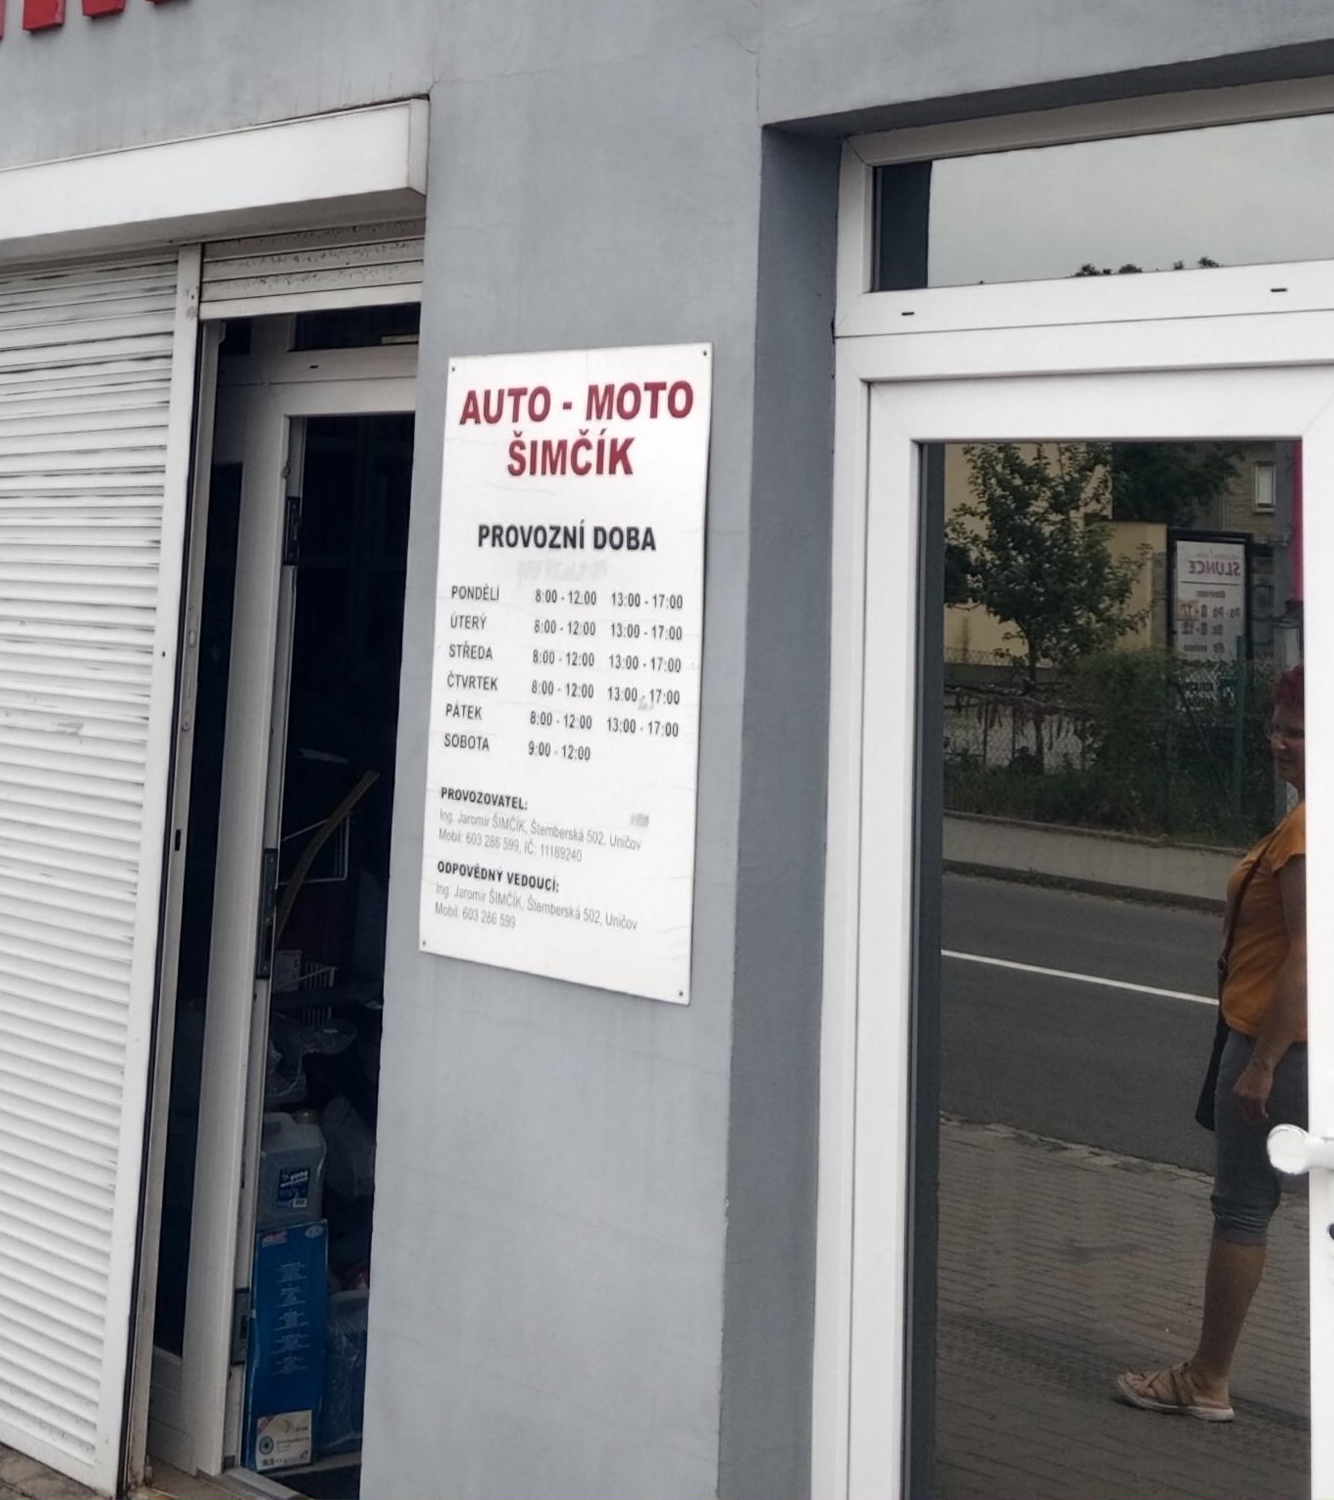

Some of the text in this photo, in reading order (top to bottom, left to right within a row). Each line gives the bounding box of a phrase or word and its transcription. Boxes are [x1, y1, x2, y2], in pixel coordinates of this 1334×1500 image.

[459, 386, 551, 425] AUTO
[586, 380, 694, 421] MOTO
[507, 428, 635, 476] ŠIMČÍK
[478, 519, 656, 551] PROVOZNÍ DOBA
[535, 589, 557, 603] 8:00
[568, 589, 597, 605] 12:00
[611, 592, 641, 607] 13:00
[652, 594, 683, 610] 17:00
[450, 613, 487, 630] ÚTERÝ
[534, 619, 556, 635] 8:00
[567, 620, 596, 636] 12:00
[610, 623, 640, 638] 13:00
[652, 625, 682, 640] 17:00
[449, 641, 492, 660] STŘEDA
[532, 649, 555, 665] 8:00
[566, 651, 595, 667] 12:00
[609, 654, 639, 670] 13:00
[650, 657, 681, 672] 17:00
[447, 671, 498, 691] ČTVRTEK
[531, 680, 554, 695] 8:00
[566, 682, 594, 698] 12:00
[607, 687, 637, 702] 13:00
[650, 689, 680, 705] 17:00
[445, 702, 482, 720] PÁTEK
[530, 710, 552, 726] 8:00
[564, 713, 592, 729] 12:00
[606, 717, 636, 733] 13:00
[648, 720, 679, 737] 17:00
[444, 732, 489, 751] SOBOTA
[528, 741, 551, 757] 9:00
[562, 744, 591, 761] 12:00
[441, 787, 528, 811] PROVOZOVATEL:
[437, 860, 503, 883] ODPOVĚDNÝ
